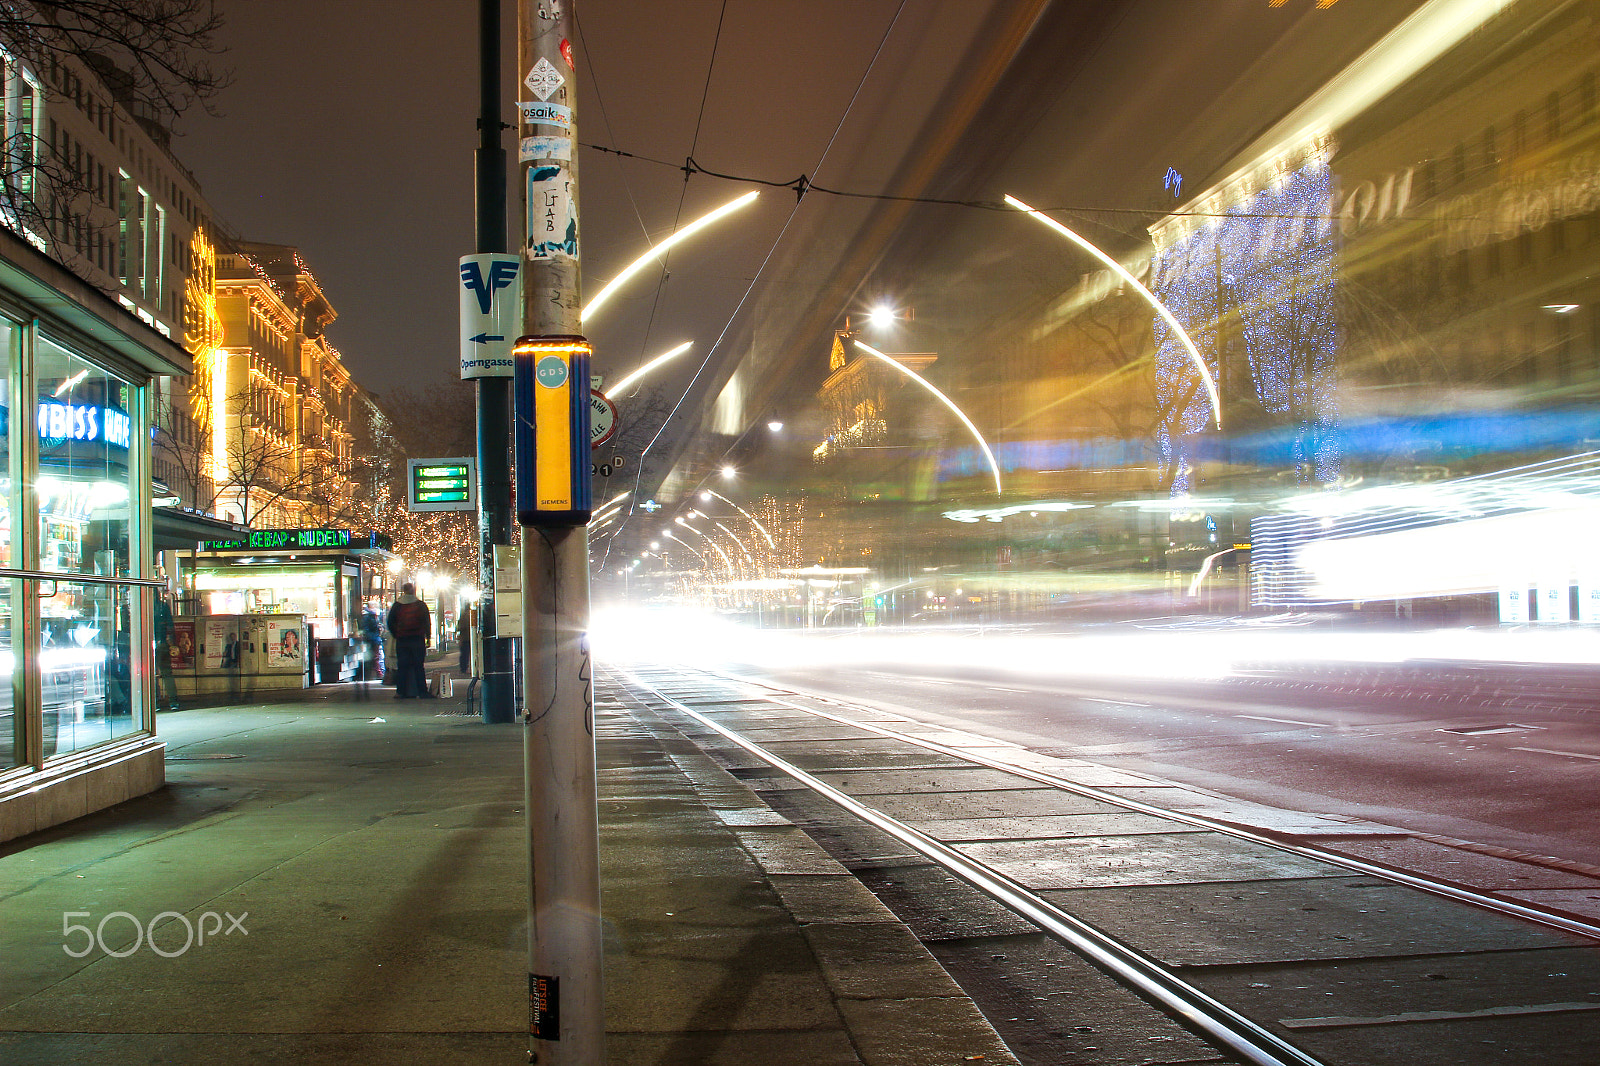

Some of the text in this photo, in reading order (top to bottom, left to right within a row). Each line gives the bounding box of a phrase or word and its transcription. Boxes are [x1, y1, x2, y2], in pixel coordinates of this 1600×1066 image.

[461, 359, 514, 370] Operngasse
[603, 464, 609, 475] 1
[614, 456, 624, 467] D
[250, 531, 288, 548] KEBAP
[298, 530, 350, 546] NUDELN
